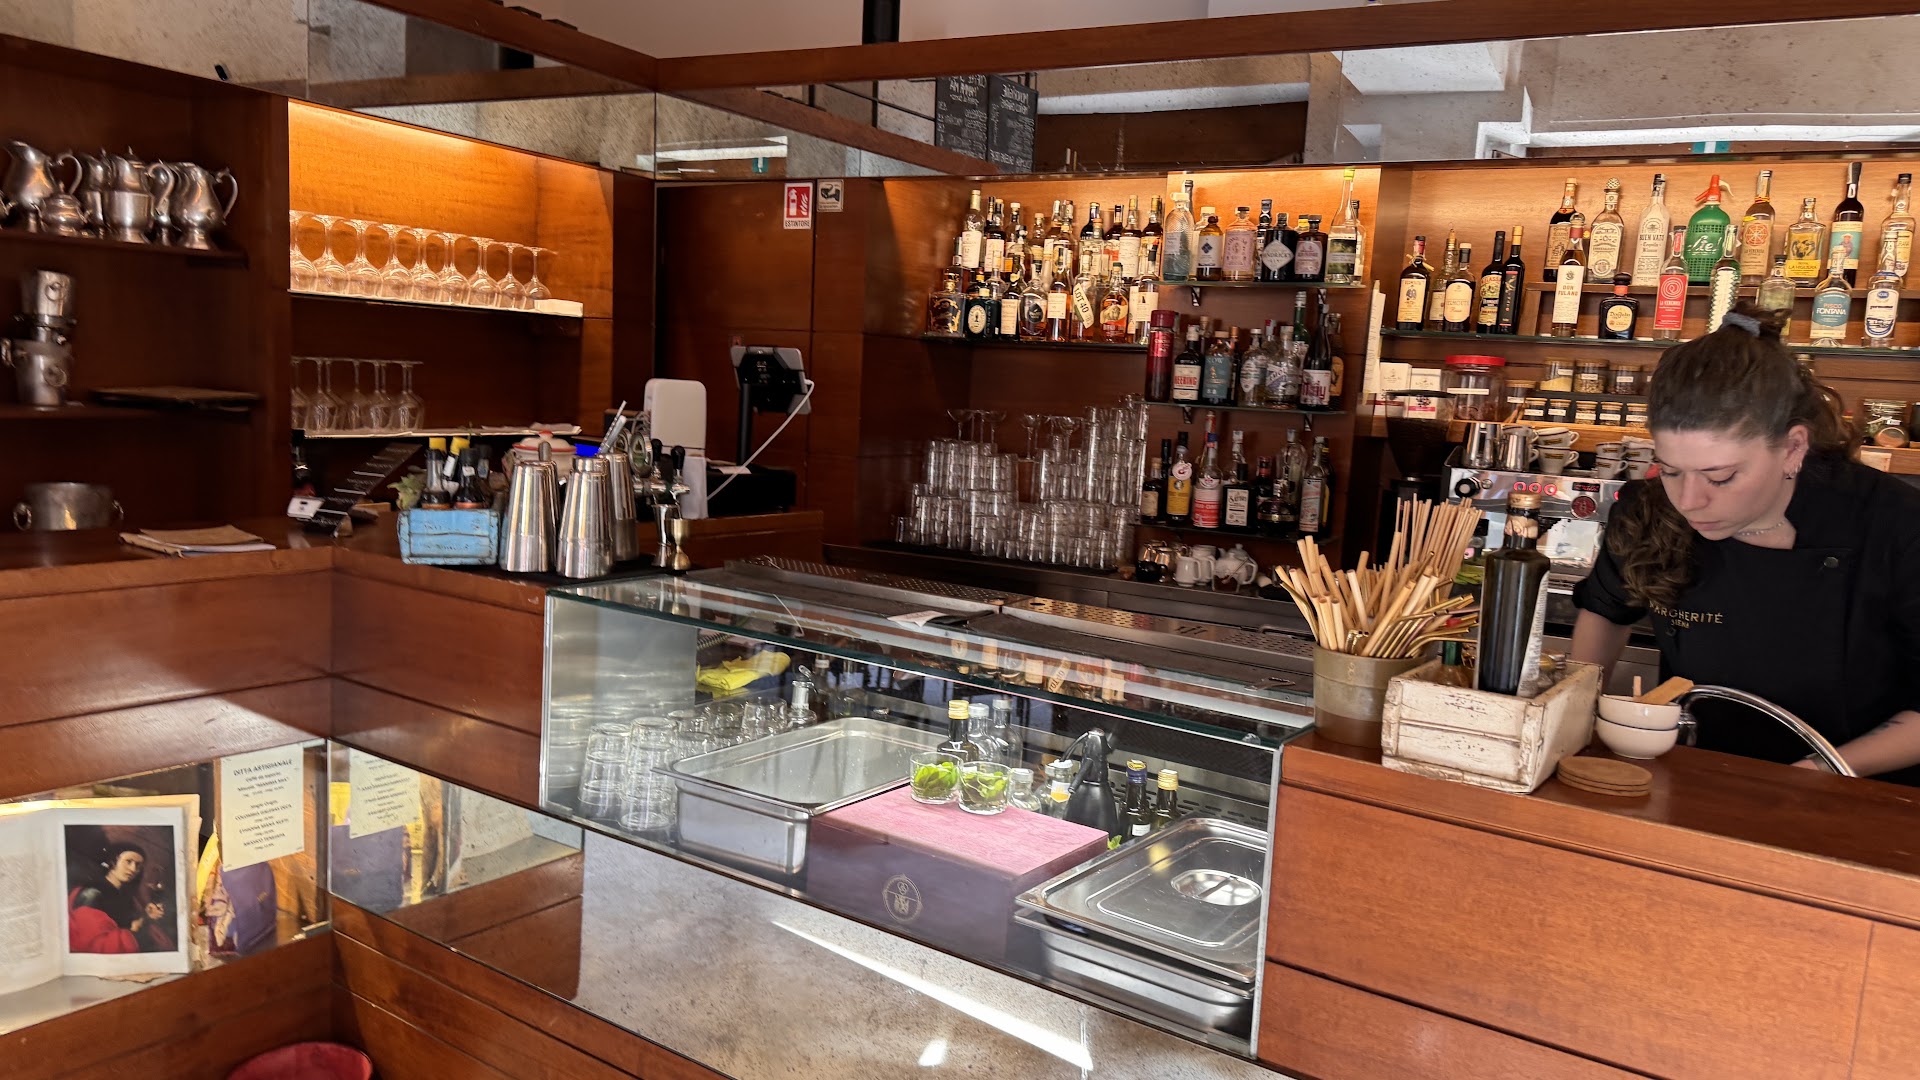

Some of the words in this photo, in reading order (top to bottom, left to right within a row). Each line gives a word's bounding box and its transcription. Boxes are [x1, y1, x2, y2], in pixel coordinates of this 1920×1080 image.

[1074, 288, 1085, 302] LOT
[1080, 303, 1089, 313] 40
[1816, 307, 1847, 315] FONTANA
